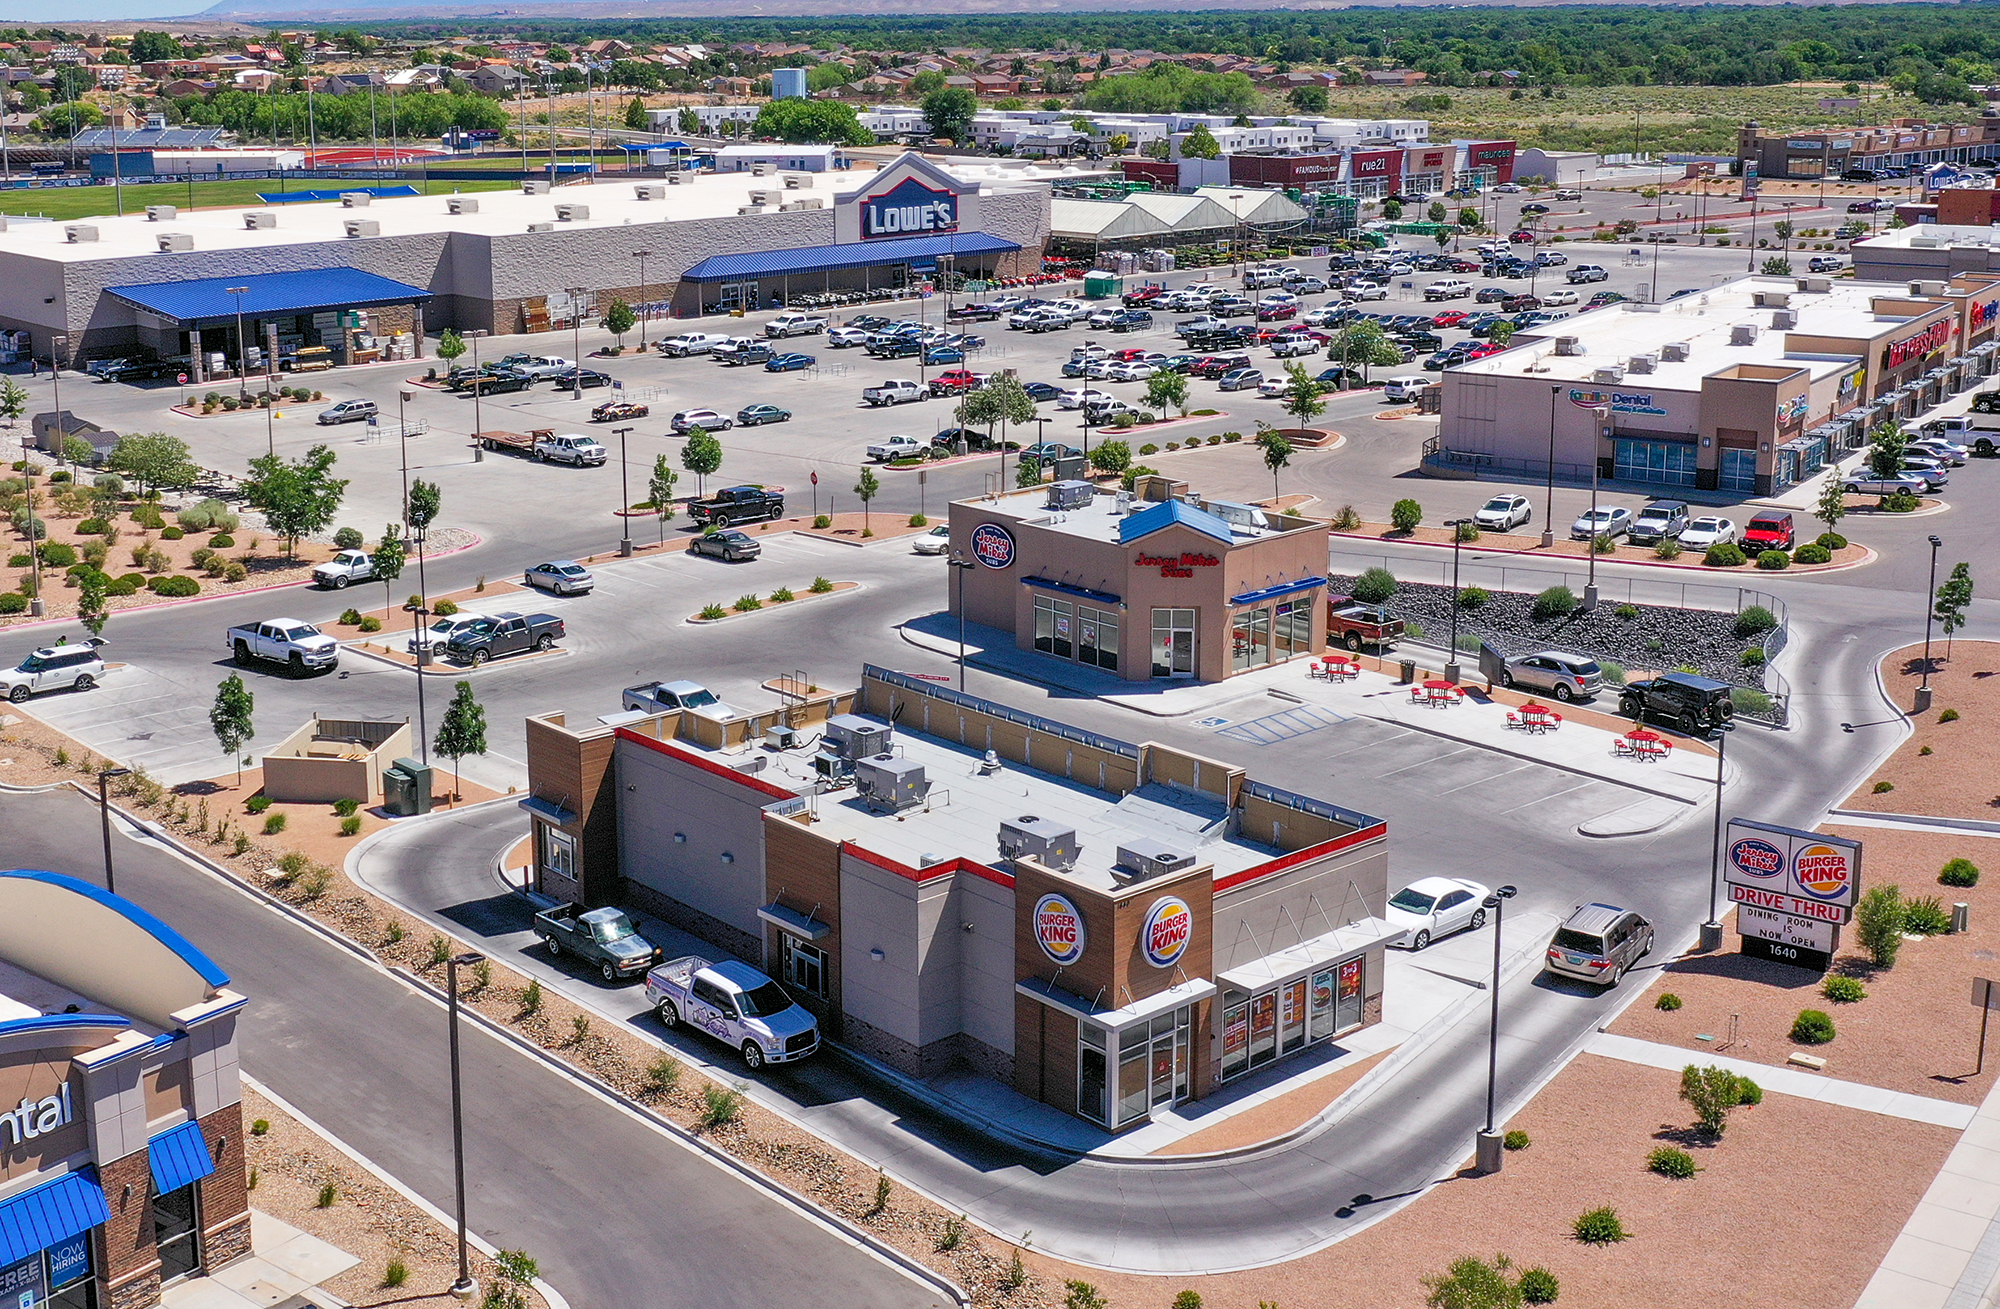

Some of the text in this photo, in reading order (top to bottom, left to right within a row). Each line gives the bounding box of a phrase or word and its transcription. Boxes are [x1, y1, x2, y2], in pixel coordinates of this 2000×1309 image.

[1361, 158, 1385, 171] rue21
[869, 200, 952, 234] LOWE'S
[1611, 392, 1652, 406] Dental
[976, 529, 1009, 552] Jersey
[1135, 552, 1178, 569] Jersey
[1738, 843, 1779, 863] Jersey
[1748, 867, 1764, 875] SUBS
[1798, 857, 1846, 870] BURGER
[1800, 867, 1847, 883] KING
[1734, 886, 1840, 921] DRIVE THRU
[1039, 913, 1075, 927] BURGER
[1153, 912, 1188, 938] BURGER
[1747, 908, 1813, 929] DINING ROOM
[1040, 926, 1077, 943] KING
[1151, 923, 1188, 951] KING
[1783, 925, 1793, 934] IS
[1759, 929, 1815, 948] NOW OPEN
[1769, 944, 1797, 959] 1640
[51, 1240, 84, 1264] NOW
[52, 1251, 86, 1273] HIRING
[20, 1273, 39, 1287] X-RAY
